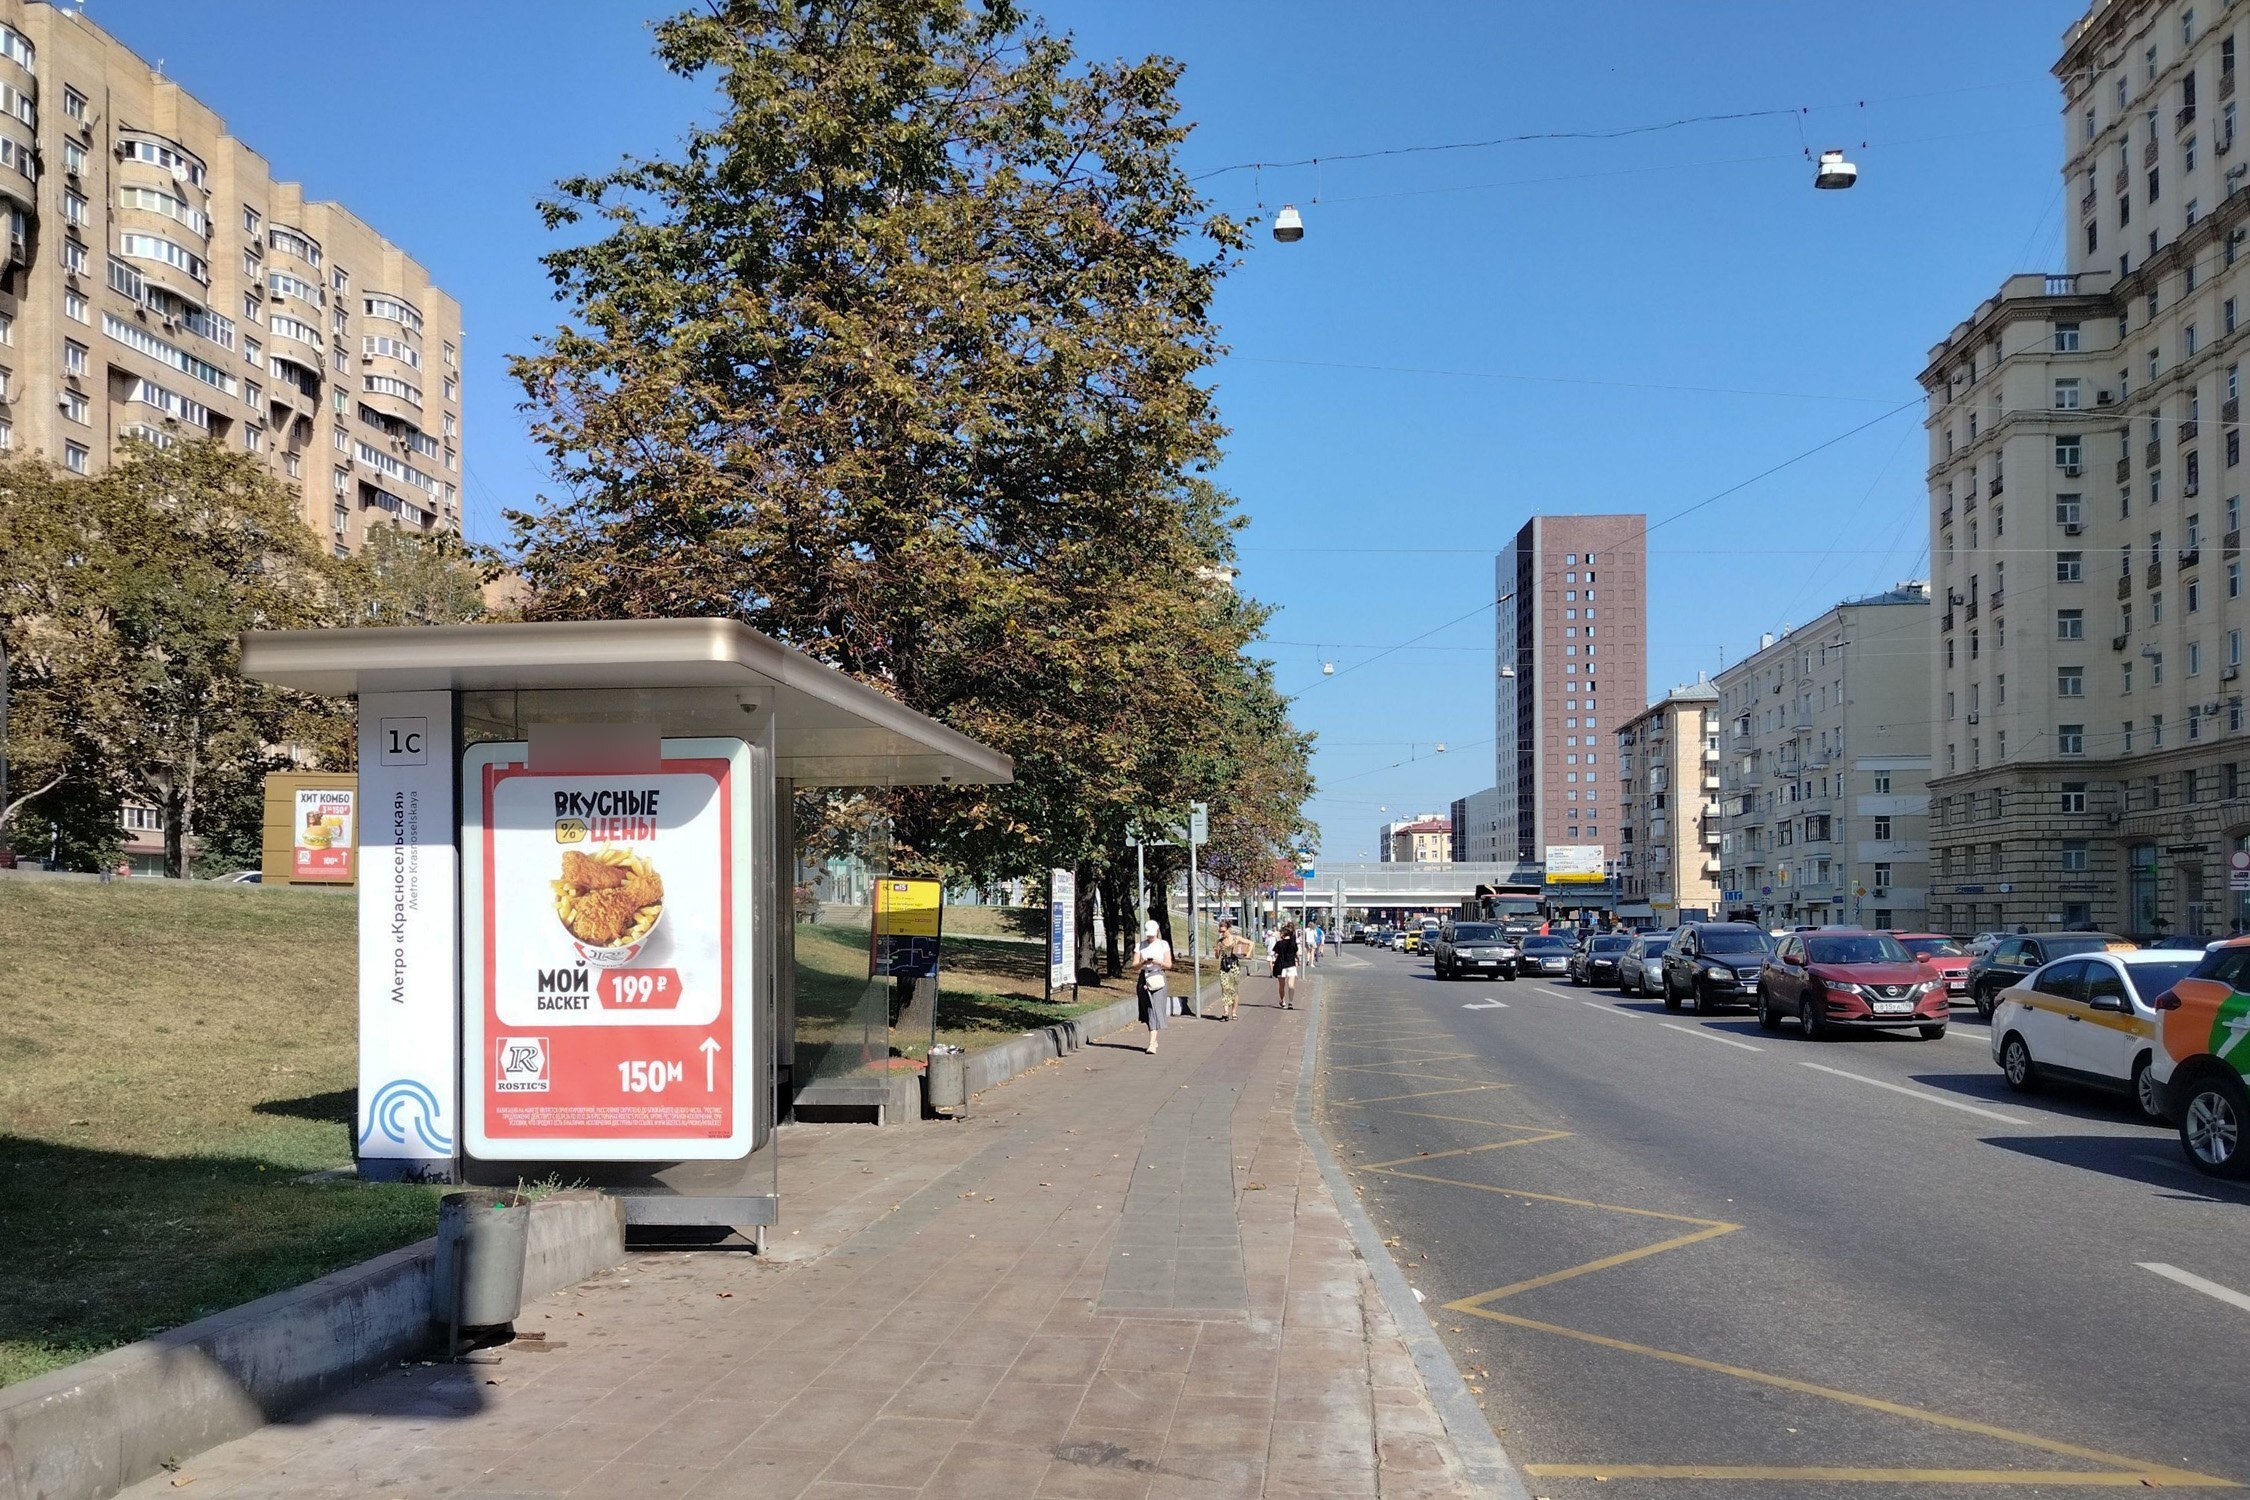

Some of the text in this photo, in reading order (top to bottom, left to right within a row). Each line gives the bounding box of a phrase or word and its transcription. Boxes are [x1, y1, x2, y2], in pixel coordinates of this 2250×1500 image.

[301, 794, 350, 803] ХИТ КОМБО
[554, 790, 660, 818] ВКУСНЫЕ
[590, 816, 656, 842] ЦЕНЫ
[408, 790, 419, 910] Metro Krasnoselskaya
[391, 791, 407, 1004] Метро «Красносельская»
[537, 960, 589, 993] МОЙ
[537, 996, 590, 1010] БАСКЕТ
[498, 1082, 548, 1090] ROSTIC'S
